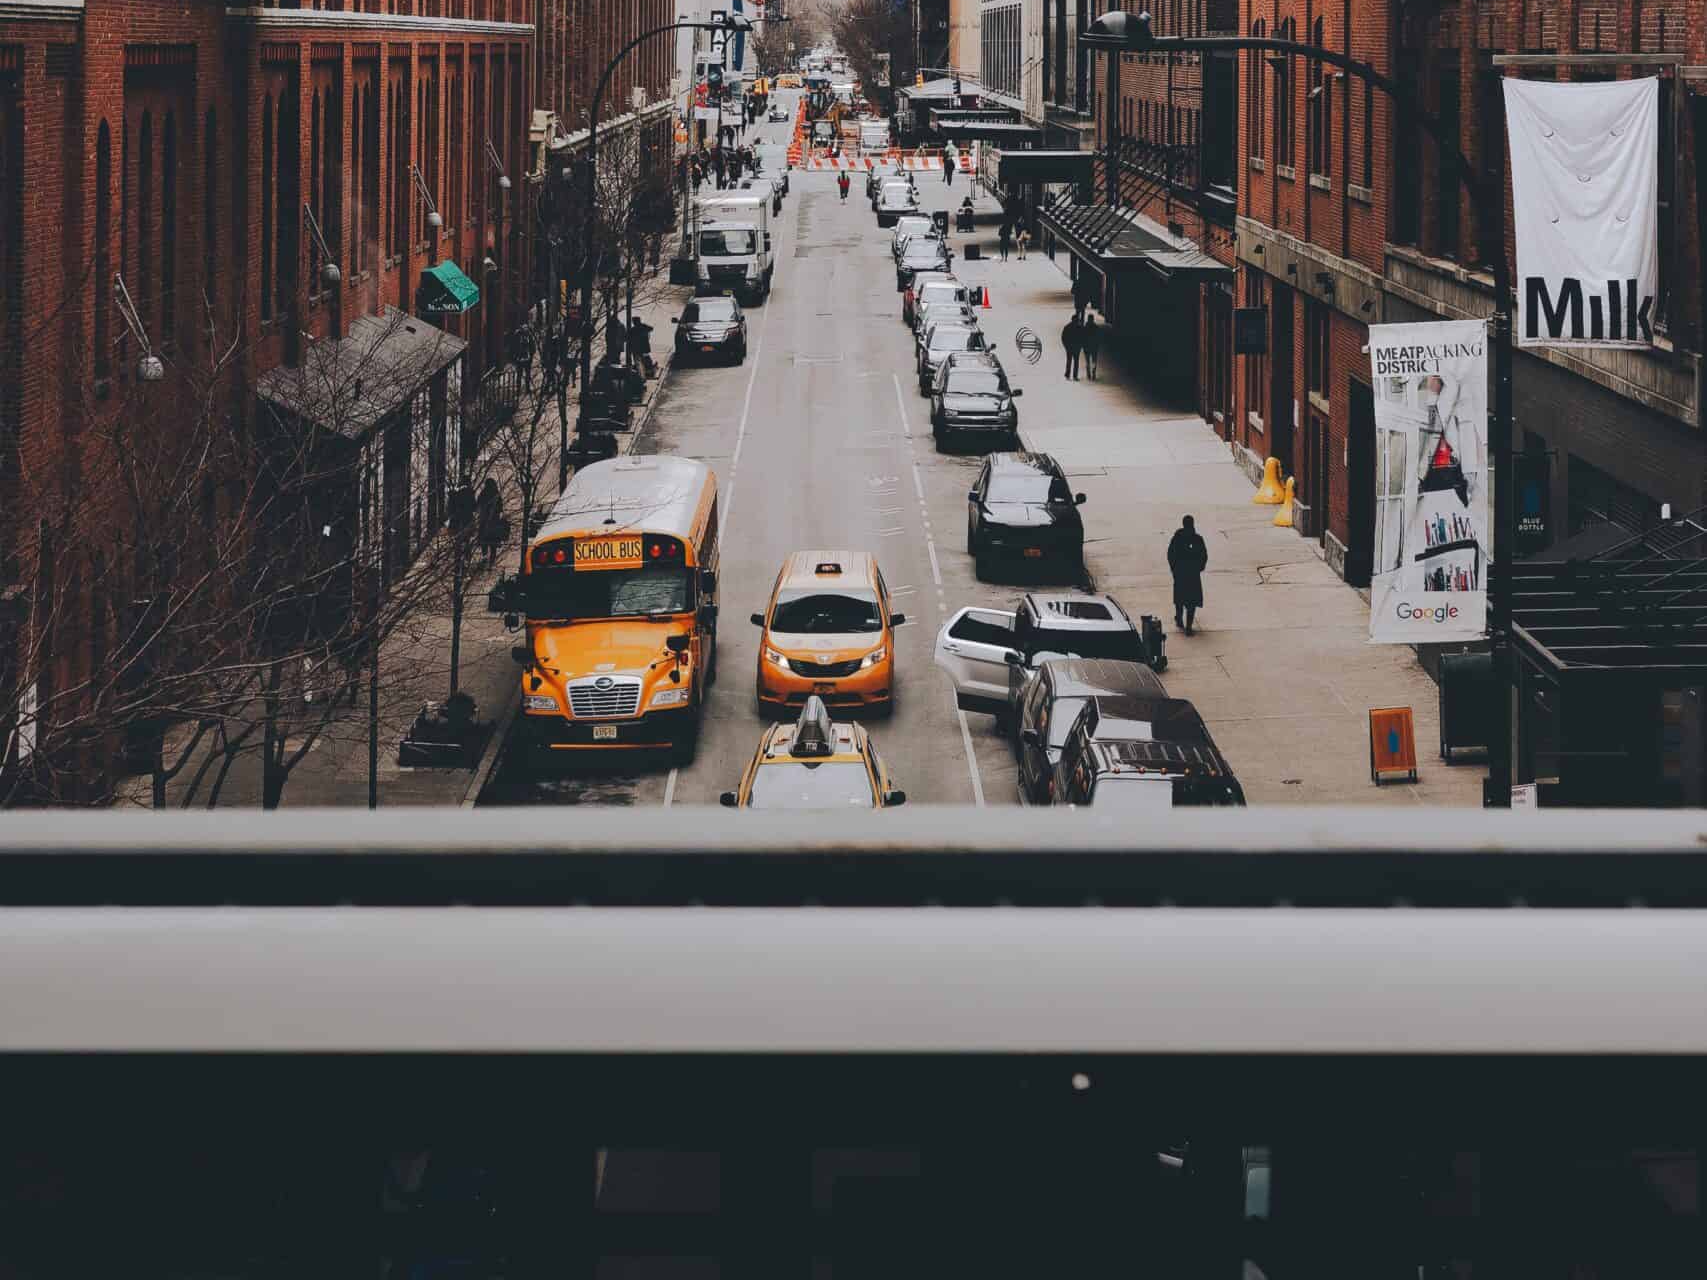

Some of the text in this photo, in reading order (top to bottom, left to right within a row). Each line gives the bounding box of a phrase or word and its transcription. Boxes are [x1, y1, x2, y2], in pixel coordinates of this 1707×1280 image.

[1526, 277, 1653, 341] Milk
[1376, 342, 1482, 360] MEATPACKING
[1377, 359, 1440, 374] DISTRICT
[575, 541, 641, 560] SCHOOL BUS
[1396, 602, 1458, 623] Google
